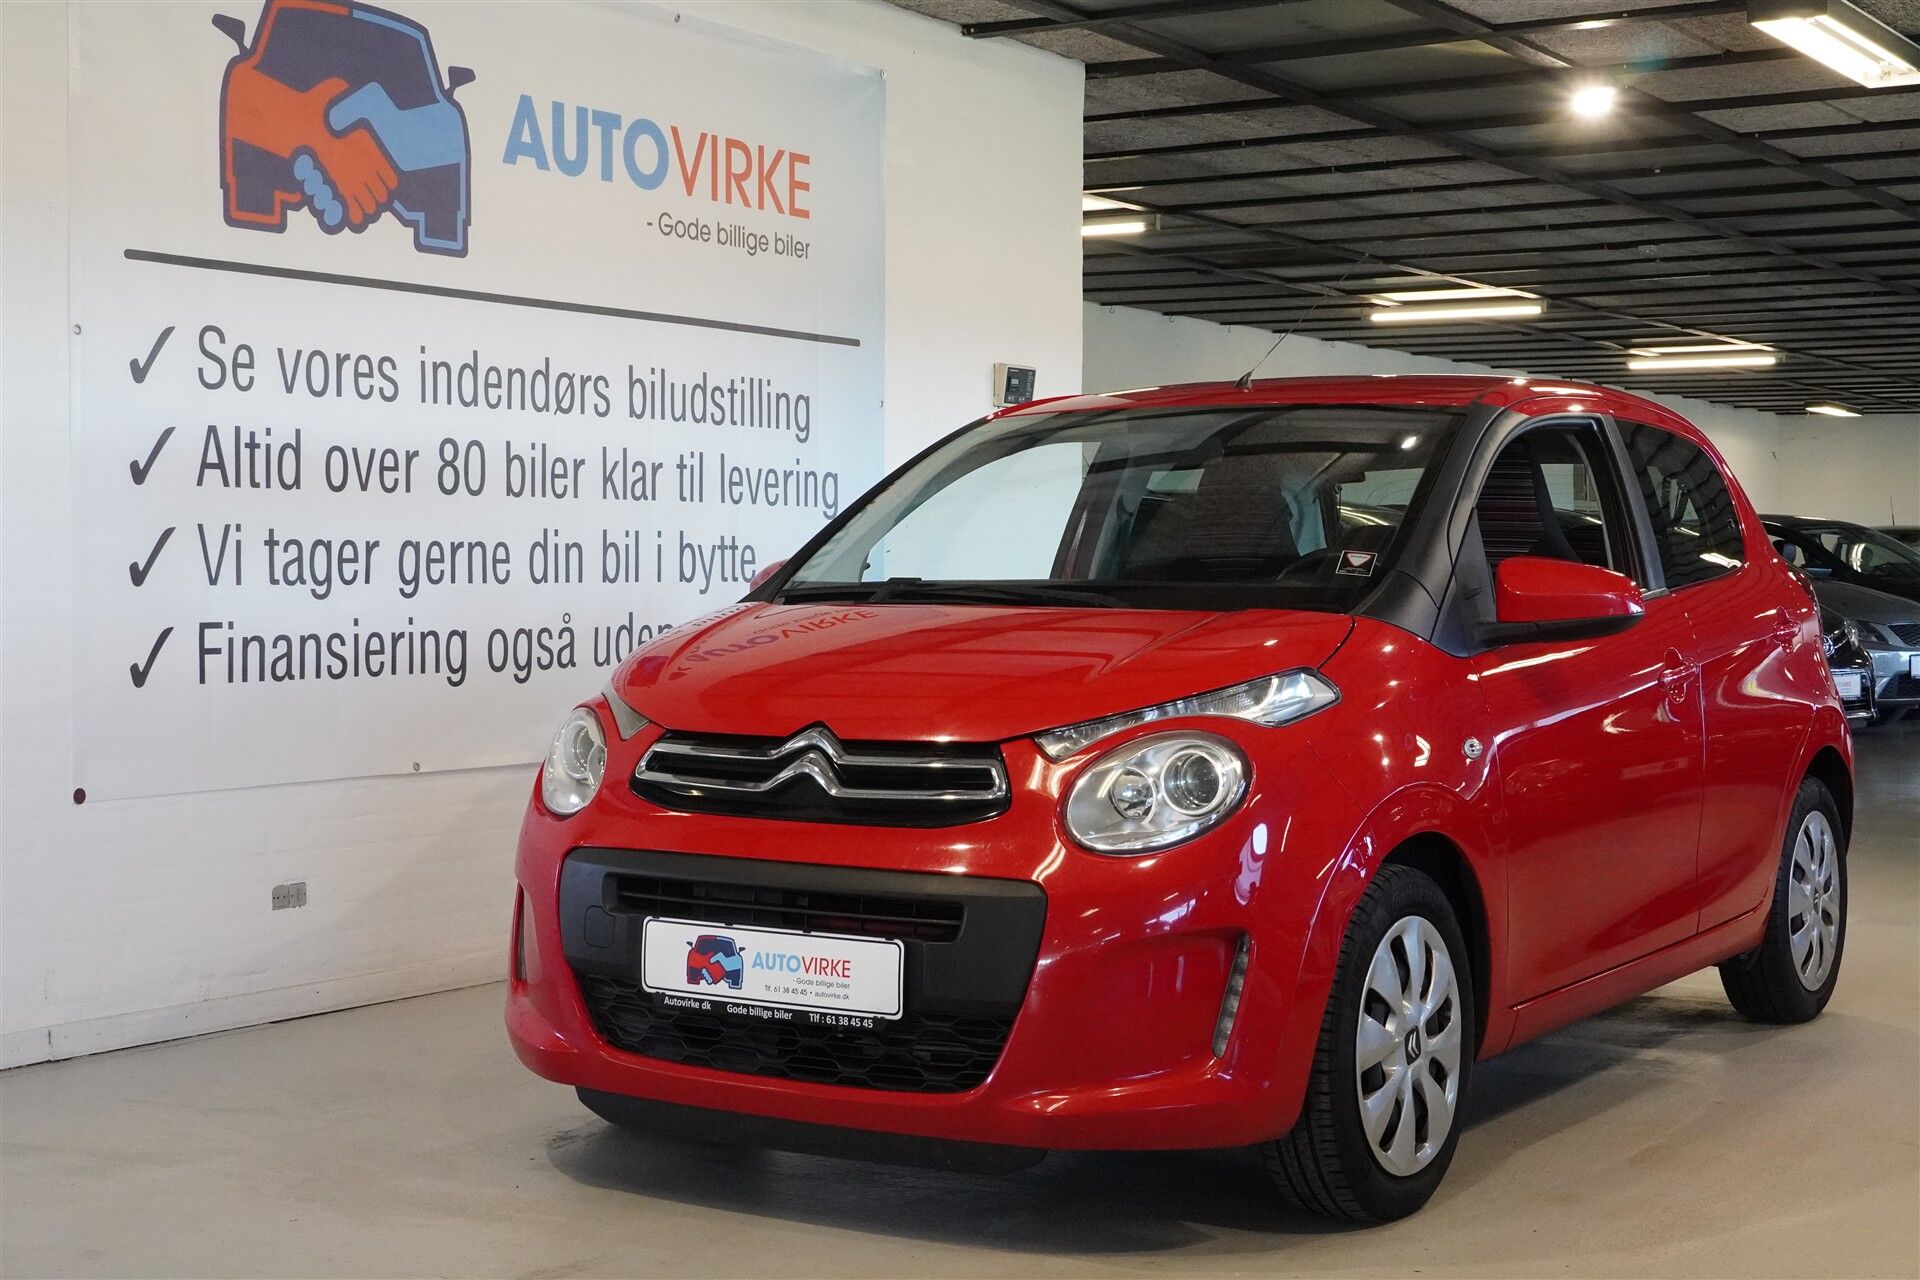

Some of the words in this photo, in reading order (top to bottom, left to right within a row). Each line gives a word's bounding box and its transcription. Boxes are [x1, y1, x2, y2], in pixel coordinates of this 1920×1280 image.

[503, 94, 811, 219] AUTOVIRKE
[658, 212, 711, 243] Gode
[717, 222, 769, 256] billige
[774, 232, 811, 259] biler
[198, 325, 255, 392] Se
[277, 348, 400, 403] vores
[420, 345, 611, 417] indendørs
[628, 365, 811, 443] biludstilling
[196, 424, 302, 492] Altid
[325, 444, 420, 495] over
[437, 438, 487, 497] 80
[505, 441, 586, 499] biler
[602, 449, 662, 502] klar
[676, 452, 704, 503] til
[719, 458, 840, 520] levering
[197, 523, 242, 586] Vi
[264, 528, 380, 600] tager
[398, 540, 511, 600] gerne
[529, 528, 583, 585] din
[602, 529, 640, 584] bil
[656, 531, 662, 583] i
[679, 531, 757, 595] bytte
[198, 617, 468, 688] Finansiering
[487, 613, 577, 684] også
[752, 952, 852, 978] AUTOVIRKE
[782, 986, 790, 994] 38
[791, 987, 799, 995] 45
[814, 991, 850, 1000] autovirke.dk
[796, 977, 814, 986] Gode
[815, 979, 835, 989] billige
[664, 996, 700, 1009] Autovirke
[701, 1001, 711, 1010] dk
[727, 1004, 748, 1014] Gode
[749, 1006, 773, 1019] billige
[774, 1009, 793, 1020] biler
[809, 1013, 820, 1023] Tlf
[826, 1015, 836, 1024] 61
[838, 1016, 849, 1026] 38
[850, 1018, 861, 1027] 45
[862, 1019, 873, 1028] 45
